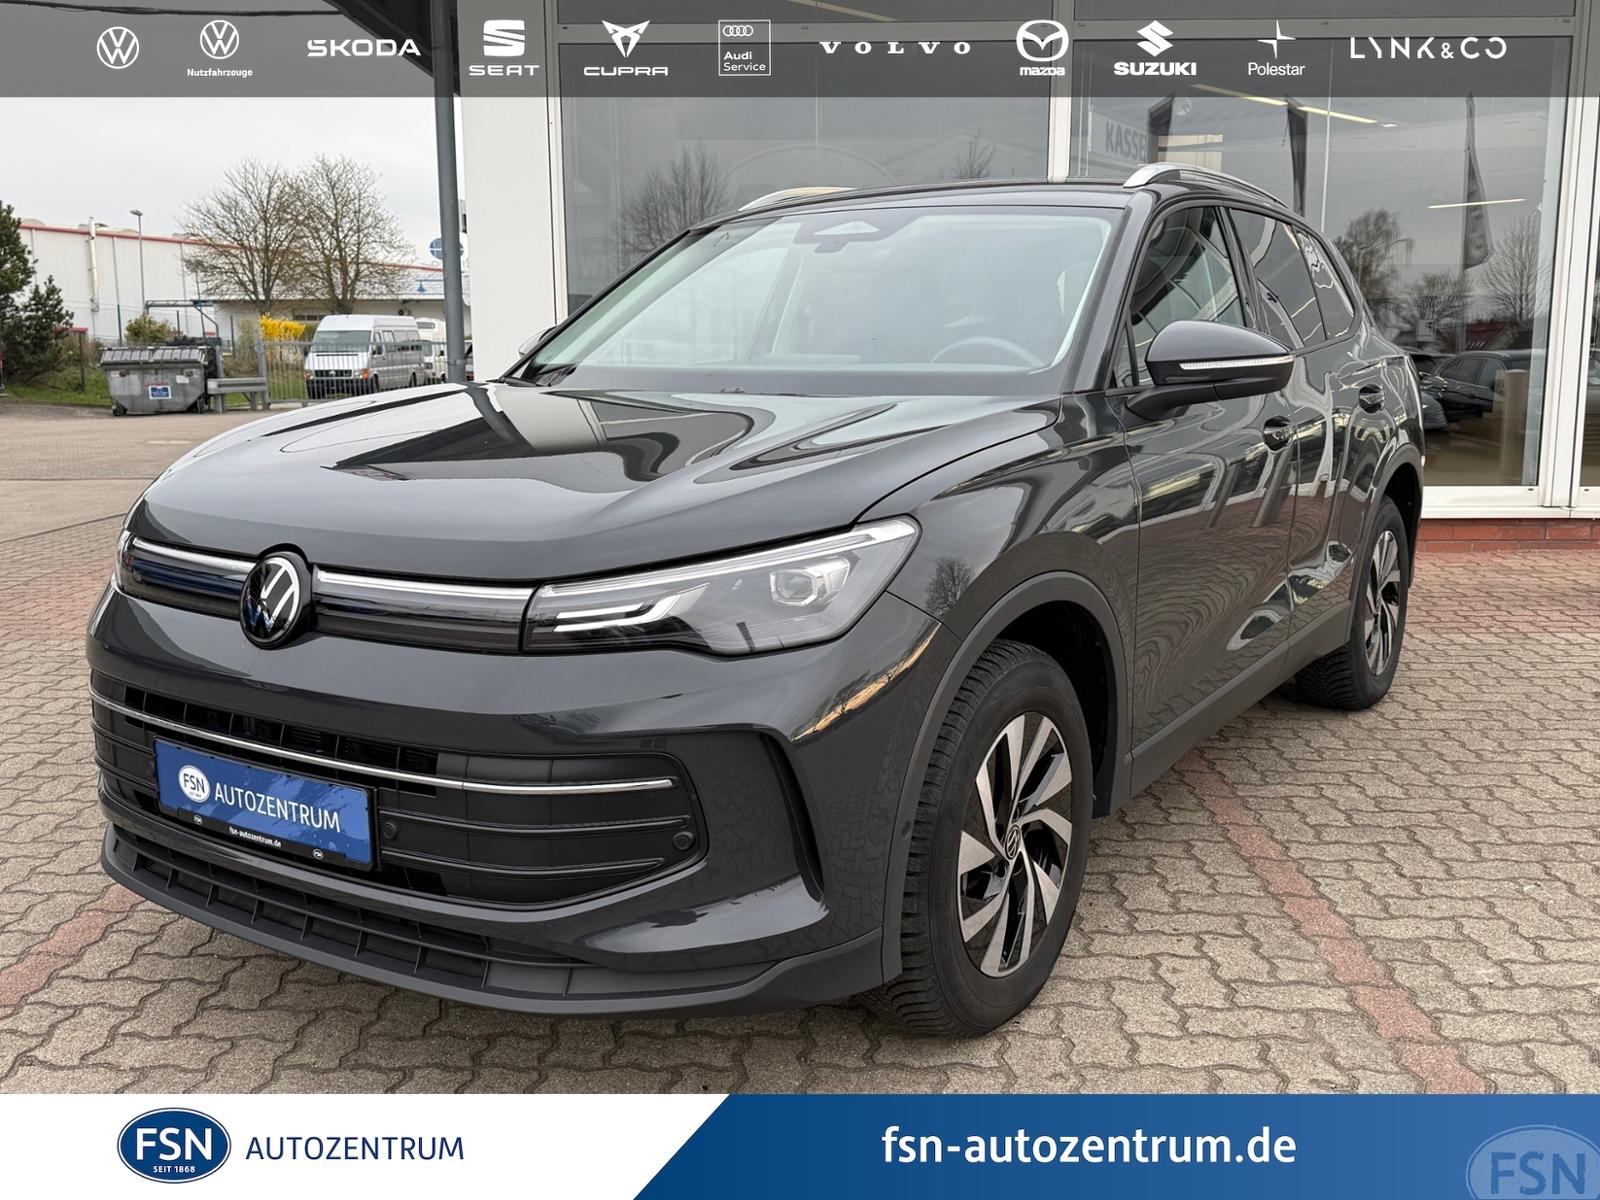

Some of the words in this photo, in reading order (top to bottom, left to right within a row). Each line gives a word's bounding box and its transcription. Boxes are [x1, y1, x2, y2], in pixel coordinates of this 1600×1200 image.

[183, 773, 206, 794] FSN
[215, 782, 341, 833] AUTOZENTRUM
[229, 826, 282, 848] fsn-autozentrum.de
